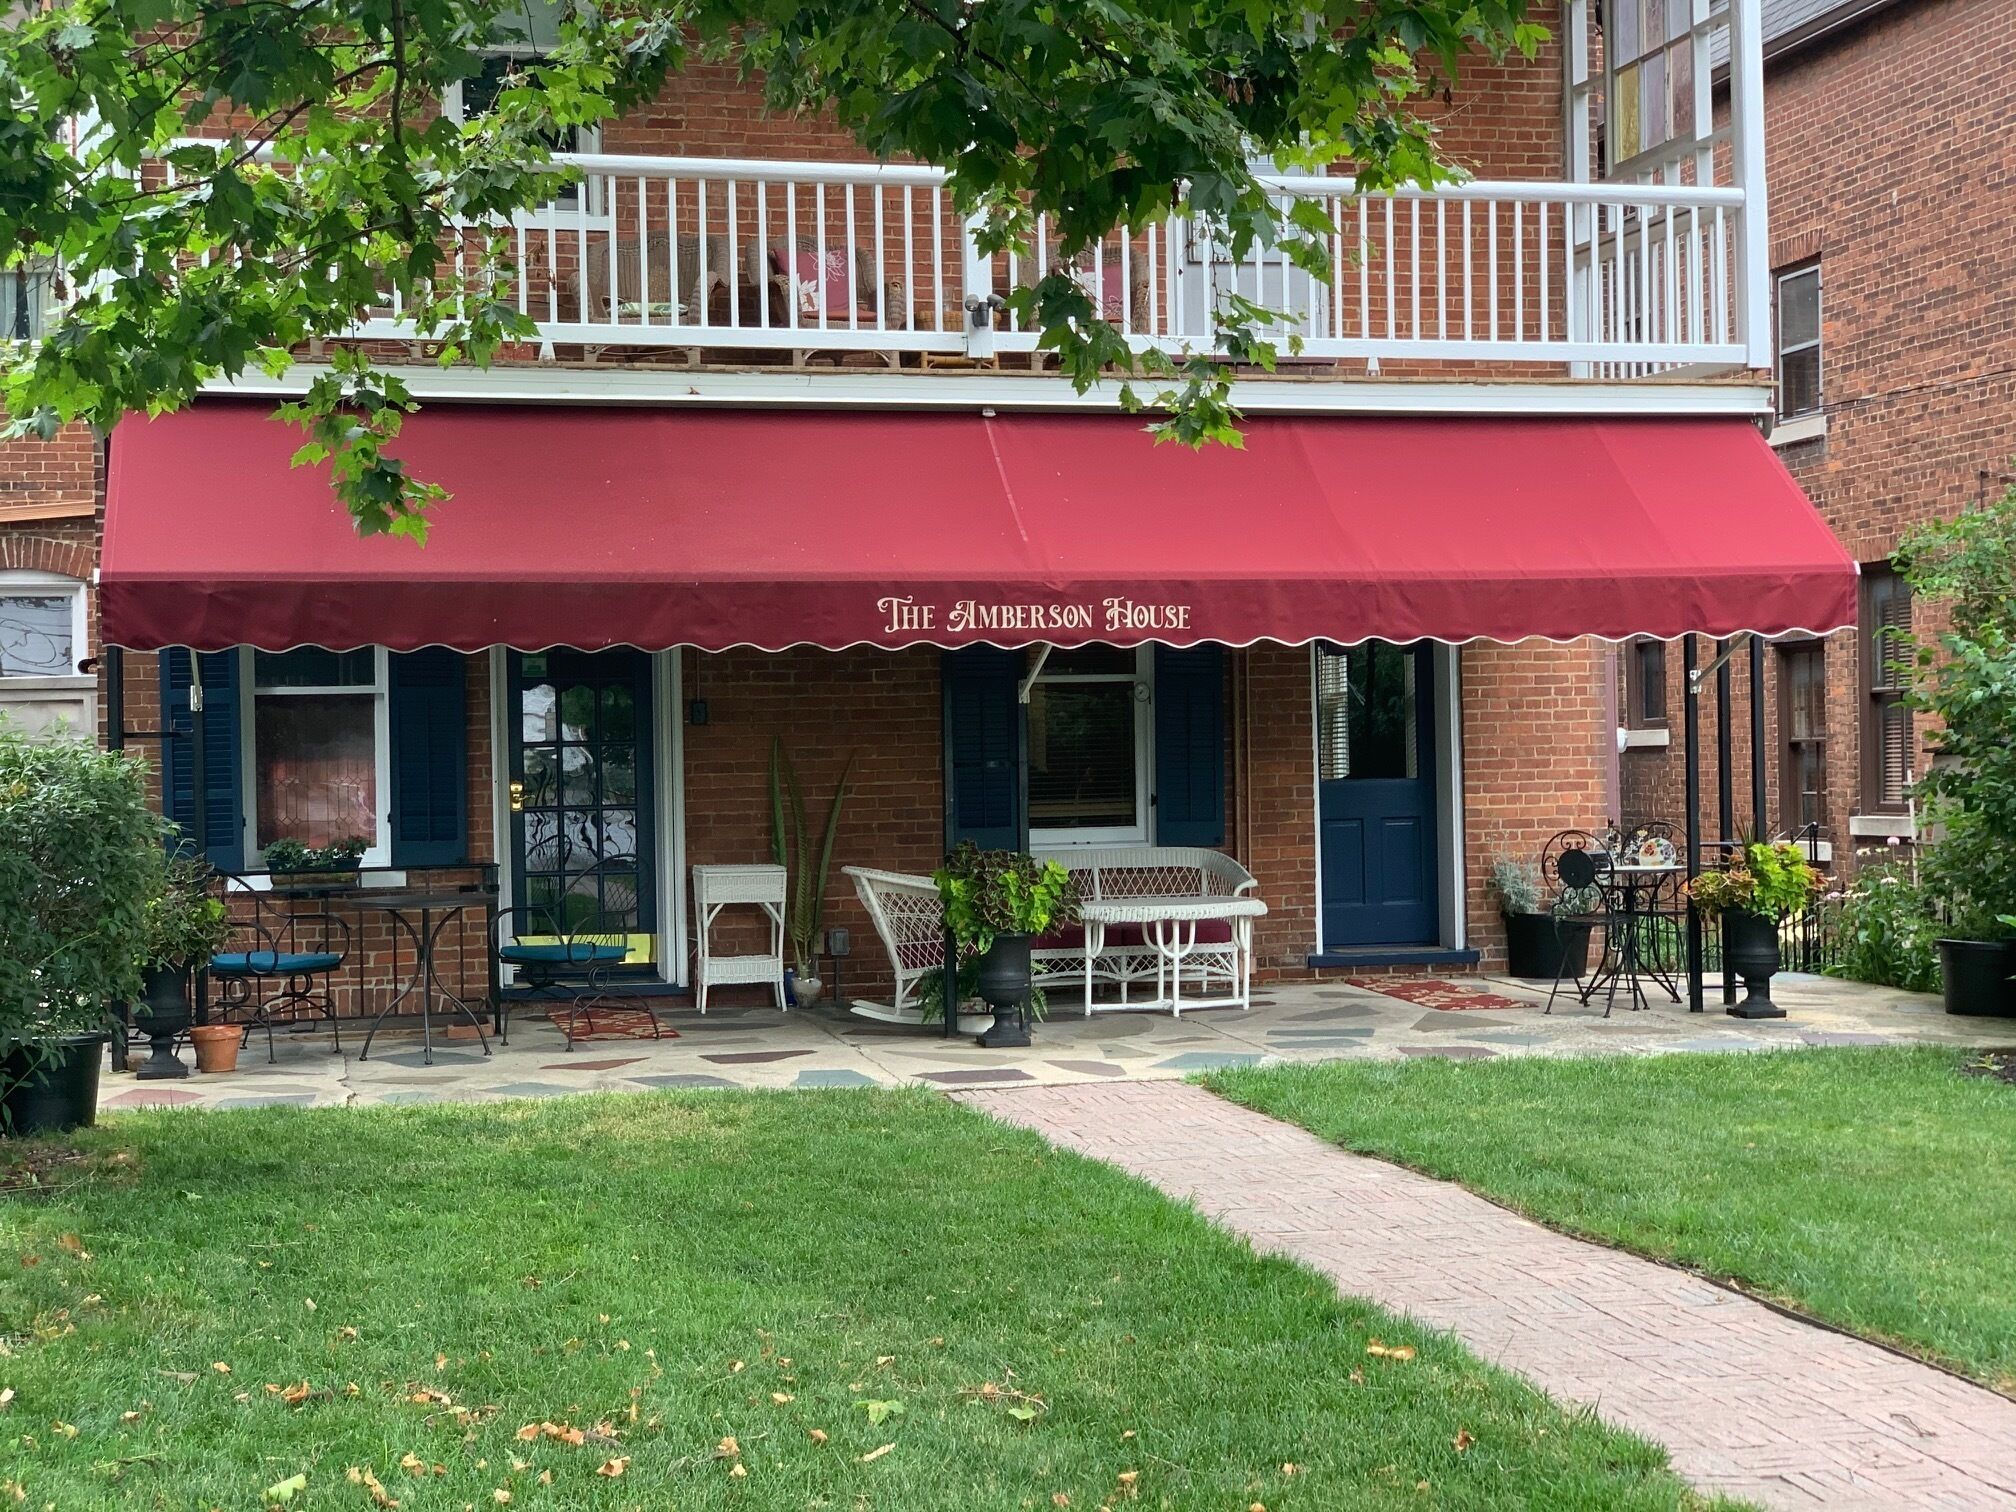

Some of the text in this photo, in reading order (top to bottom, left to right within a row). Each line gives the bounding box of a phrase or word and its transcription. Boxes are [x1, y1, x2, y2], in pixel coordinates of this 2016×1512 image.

[876, 595, 1192, 633] THE AMBERSON HOUSE
